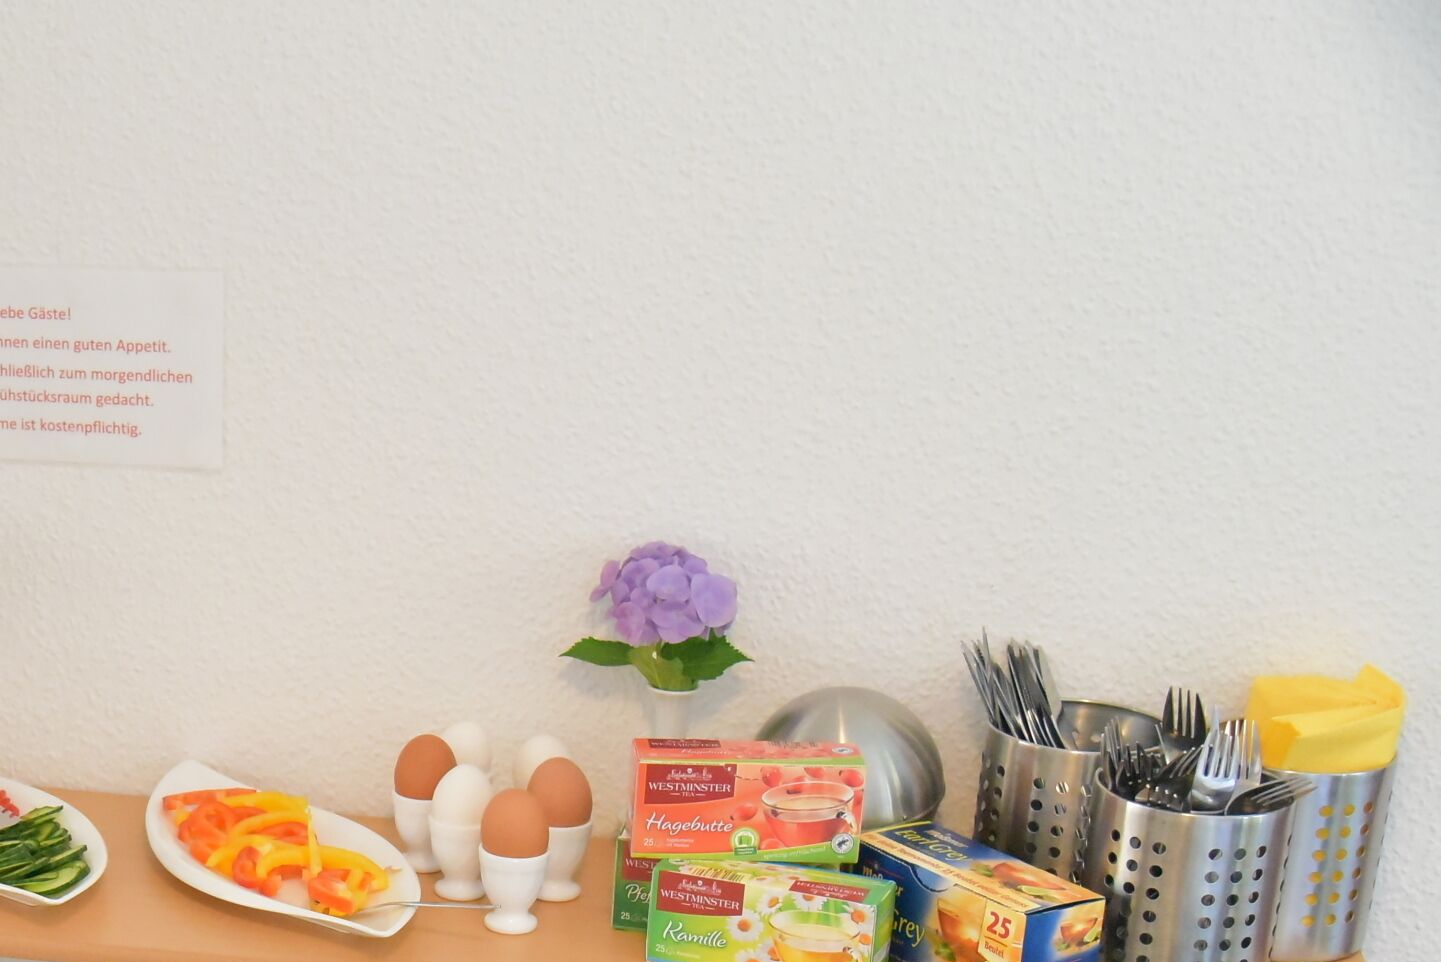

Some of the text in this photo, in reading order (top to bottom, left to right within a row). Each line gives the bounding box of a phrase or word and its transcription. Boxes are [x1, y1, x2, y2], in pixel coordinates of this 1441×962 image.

[28, 306, 72, 321] Gäste!
[32, 336, 70, 350] einen
[73, 338, 112, 354] guten
[116, 339, 172, 355] Appetit.
[59, 368, 87, 380] zum
[91, 367, 193, 385] morgendlichen
[96, 392, 154, 408] gedacht.
[21, 418, 36, 431] ist
[40, 418, 142, 438] kostenpflichtig.
[648, 781, 732, 793] WESTMINSTER
[646, 811, 733, 836] Hagebutte
[643, 838, 654, 847] 25
[660, 888, 740, 911] WESTMINSTER
[621, 911, 630, 920] 25
[663, 920, 727, 948] Kamille
[986, 911, 1012, 939] 25
[655, 943, 665, 953] 25
[984, 941, 1004, 959] Beutel
